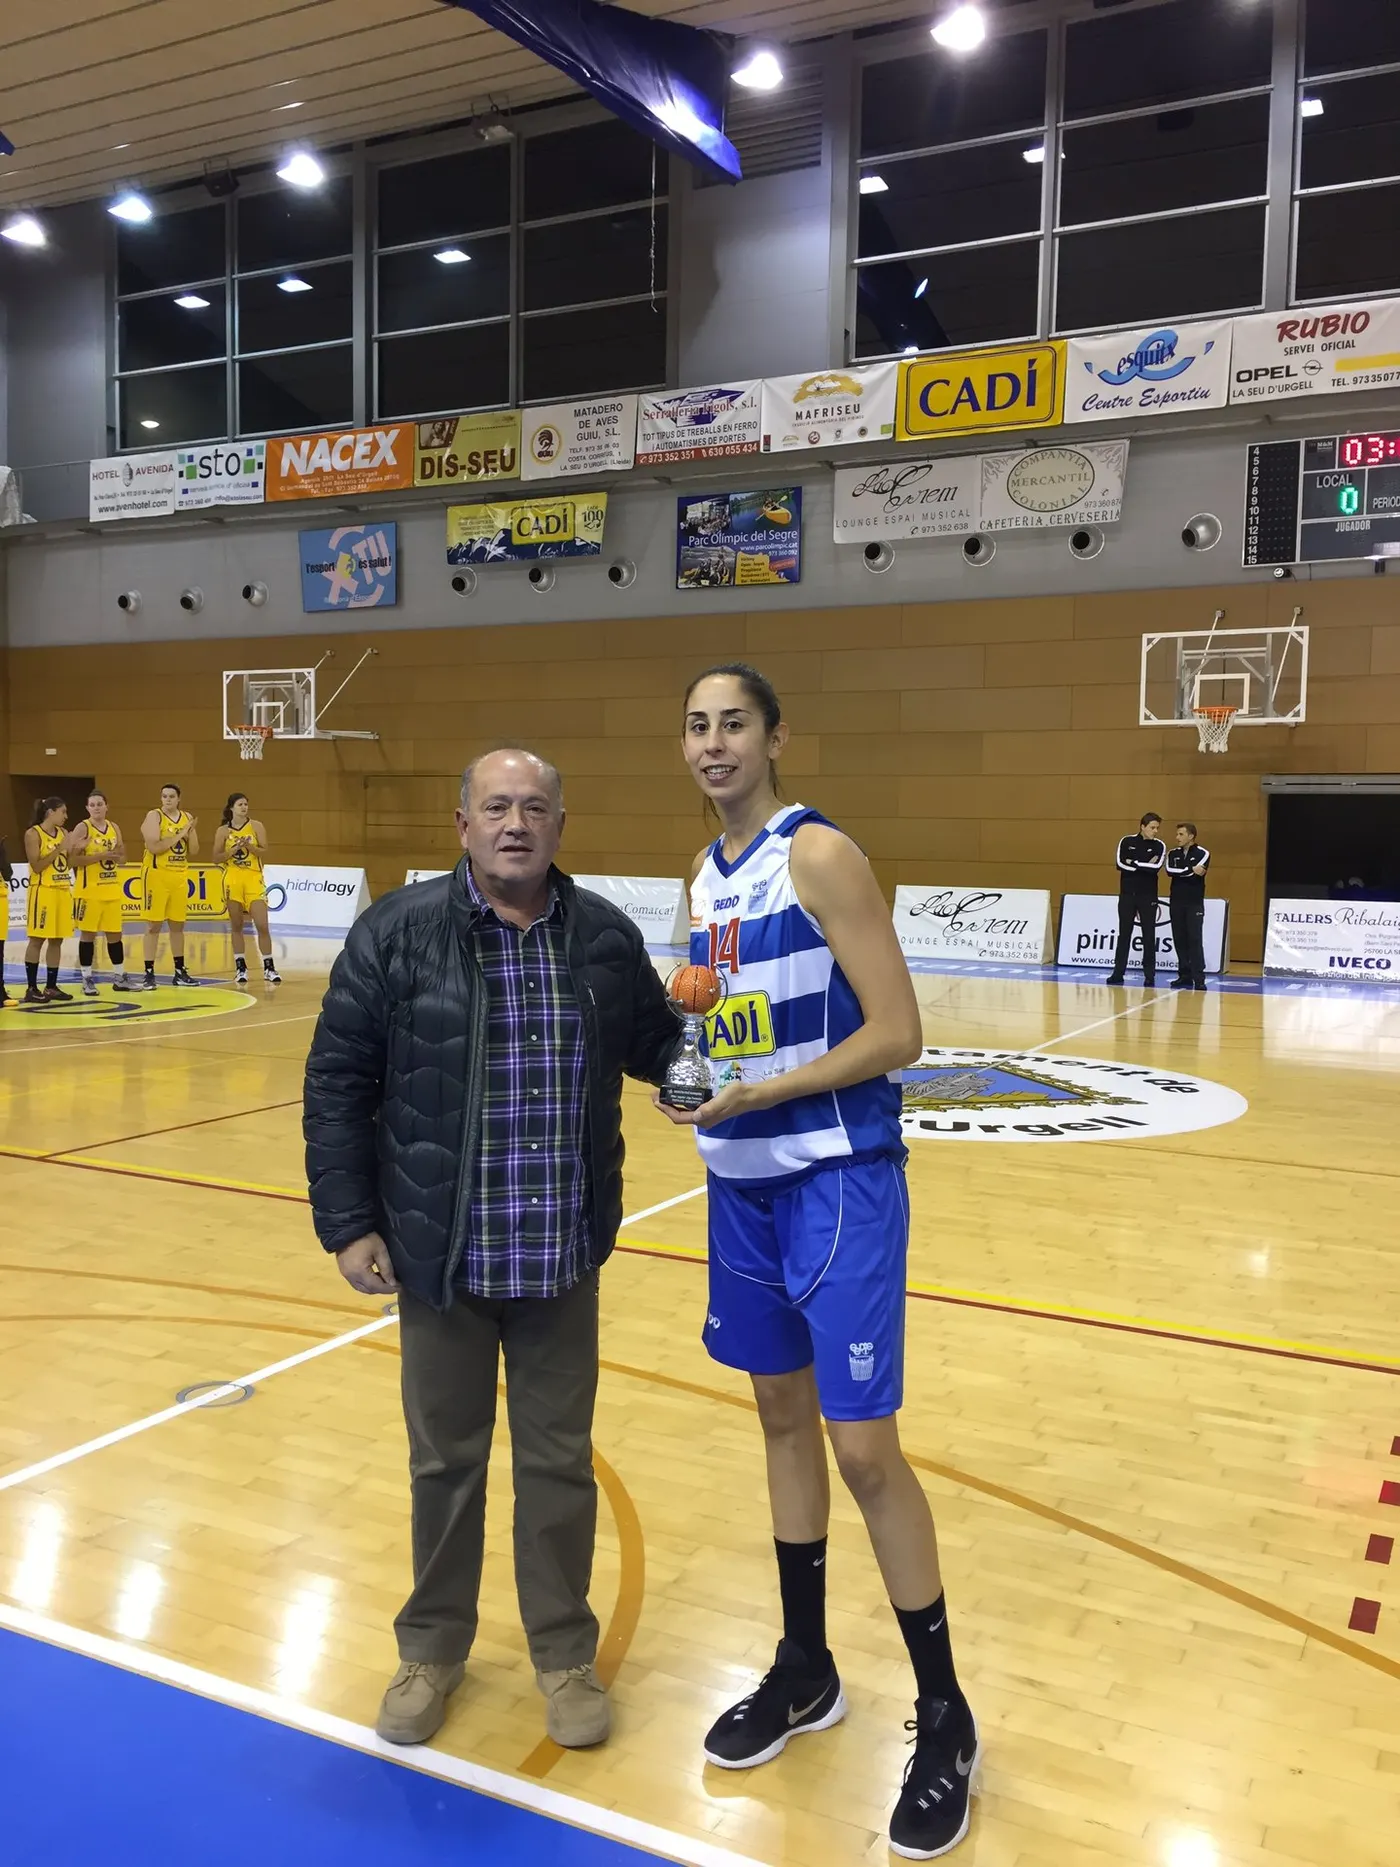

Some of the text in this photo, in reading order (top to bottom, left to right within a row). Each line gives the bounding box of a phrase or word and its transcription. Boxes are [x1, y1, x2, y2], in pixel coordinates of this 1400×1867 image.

[1276, 311, 1371, 343] RUBIO
[1284, 339, 1357, 356] SERVEI OFICIAL
[1236, 365, 1298, 383] OPEL
[919, 358, 1039, 418] CADÍ
[1232, 381, 1314, 398] LA SEU D'URGELL
[1331, 378, 1350, 387] TEL.
[1082, 386, 1212, 412] Centre Esportiu
[574, 403, 623, 418] MATADERO
[795, 403, 861, 421] MAFRISEU
[578, 415, 619, 429] DE AVES
[576, 430, 601, 442] GUIU,
[643, 421, 758, 441] TOT TIPUS DE TREBALLS EN FERRO
[655, 437, 707, 451] AUTOMATISMES
[708, 437, 717, 445] DE
[719, 433, 747, 443] PORTES
[280, 429, 400, 477] NACEX
[648, 443, 758, 464] 973 352 351 630 055 434
[1253, 447, 1260, 456] 4
[198, 448, 241, 479] sto
[420, 447, 516, 480] DIS-SEU
[1013, 450, 1087, 477] COMPANYIA
[1253, 457, 1260, 466] 5
[92, 463, 175, 482] HOTEL AVENIDA
[1252, 467, 1259, 476] 6
[1011, 472, 1091, 488] MERCANTIL
[1252, 477, 1259, 485] 7
[1316, 473, 1353, 488] LOCAL
[1012, 486, 1088, 510] COLONIAL
[1251, 486, 1258, 496] 8
[98, 500, 168, 514] www.avenhotel.com
[1084, 500, 1097, 509] 973
[1251, 496, 1258, 505] 9
[1340, 487, 1359, 515] 0
[836, 509, 971, 528] LOUNGE ESPAI MUSICAL
[1249, 506, 1260, 515] 10
[516, 508, 568, 537] CADÍ
[921, 522, 969, 534] 973 352 638
[1249, 516, 1259, 524] 11
[1335, 520, 1371, 533] JUGADOR
[689, 529, 798, 546] Parc Olímpic del Segre
[1248, 526, 1259, 535] 12
[1248, 536, 1258, 545] 13
[1247, 555, 1257, 564] 15
[286, 878, 356, 896] hidrology
[187, 903, 213, 911] NTEGA
[1274, 912, 1333, 925] TALLERS
[708, 916, 741, 975] 14
[900, 936, 1039, 950] OUNGE ESPAI MUSICAL
[1076, 928, 1173, 953] piries
[1006, 951, 1021, 959] 352
[1023, 952, 1038, 960] 638
[1328, 956, 1392, 970] IVECO
[704, 1000, 761, 1050] ADÍ
[1142, 1077, 1200, 1094] de
[902, 1115, 1150, 1136] 'Urgell
